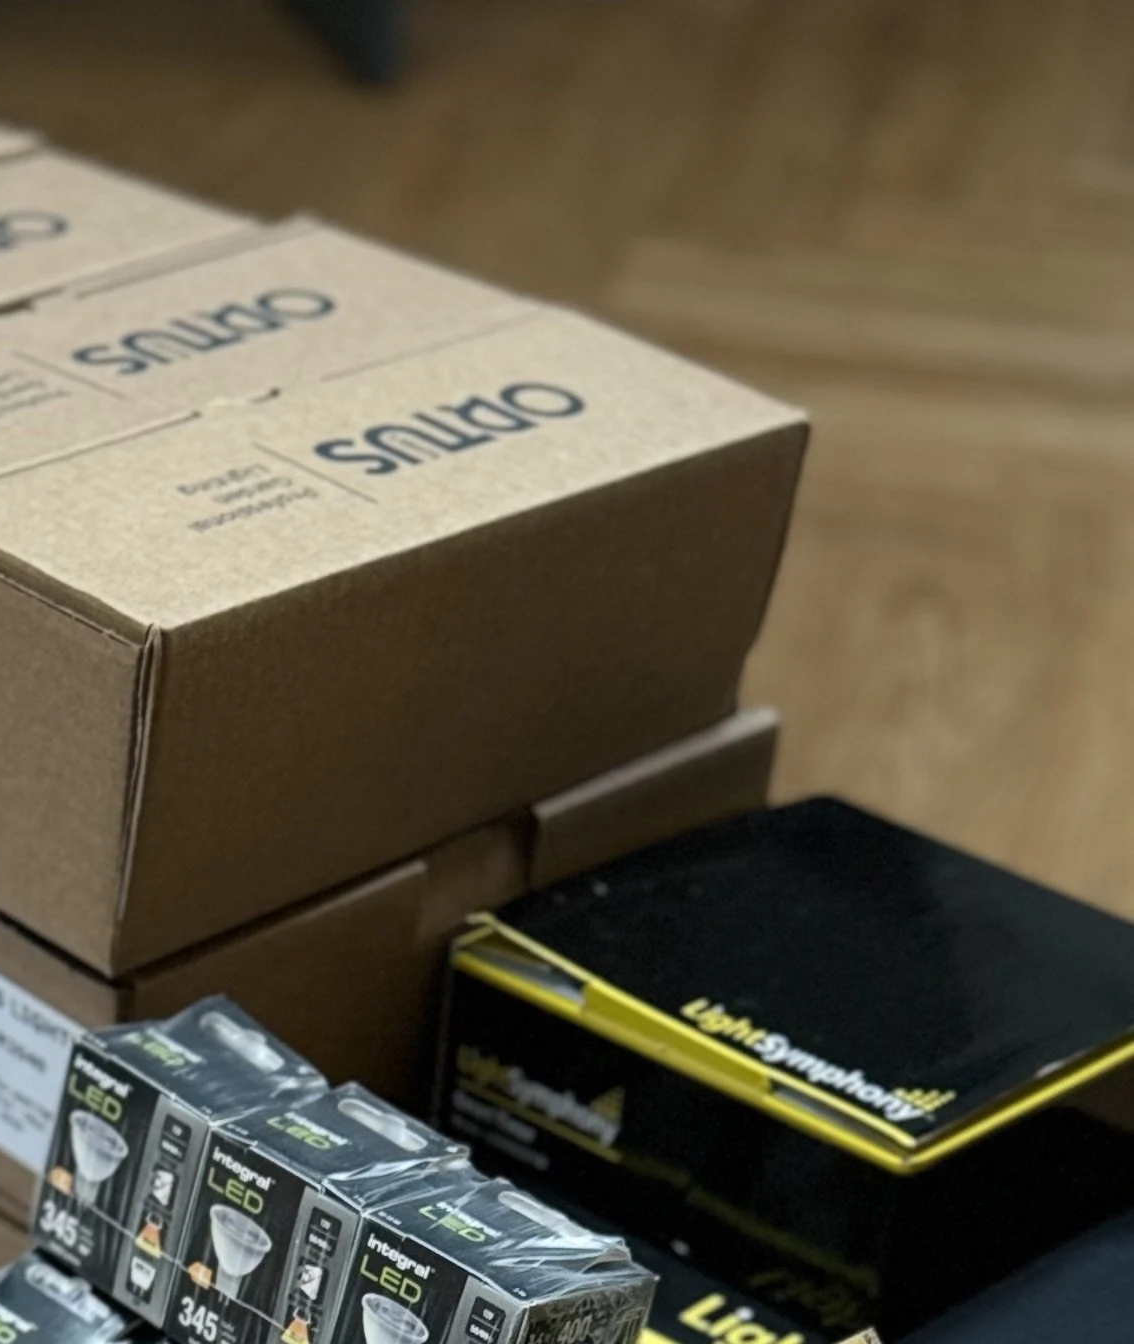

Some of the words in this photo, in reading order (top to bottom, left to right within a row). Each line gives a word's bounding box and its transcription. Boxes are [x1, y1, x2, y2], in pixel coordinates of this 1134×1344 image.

[72, 286, 336, 375] ORTUS
[312, 381, 586, 476] ORTUS
[680, 997, 926, 1122] LightSymphony
[68, 1075, 123, 1122] LED
[268, 1113, 333, 1151] LED
[207, 1167, 264, 1215] LED
[39, 1200, 79, 1248] 345
[420, 1203, 488, 1244] LED
[360, 1254, 423, 1304] LED
[178, 1296, 220, 1342] 345
